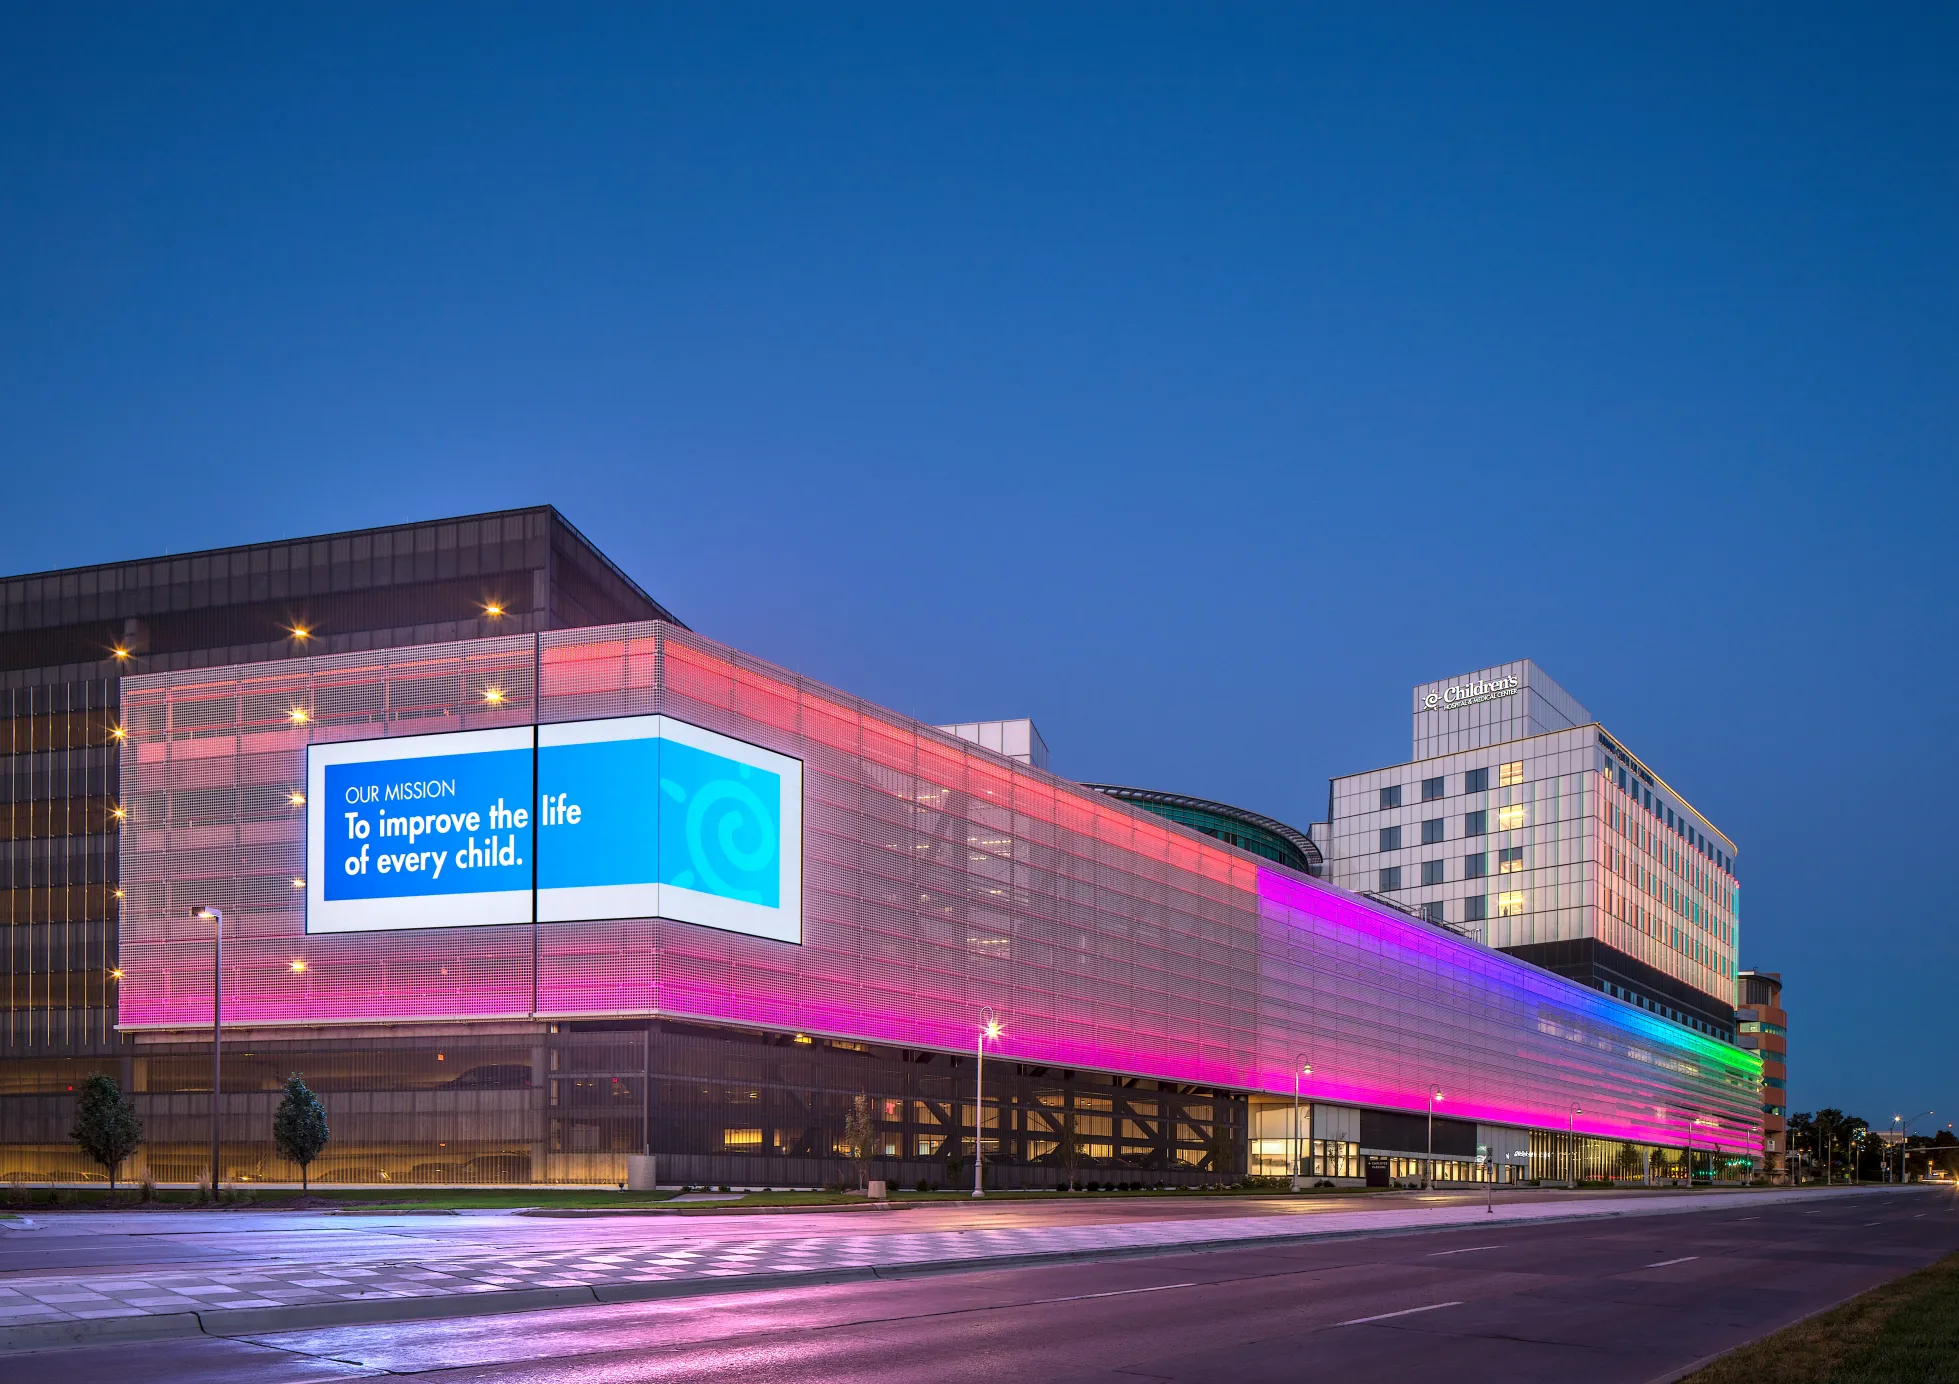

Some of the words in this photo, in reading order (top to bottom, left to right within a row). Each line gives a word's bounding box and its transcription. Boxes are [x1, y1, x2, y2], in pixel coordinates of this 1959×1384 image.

[1444, 675, 1518, 703] Children's
[1444, 700, 1468, 711] HOSPITAL
[1473, 693, 1497, 703] MEDICAL
[1497, 689, 1518, 698] CENTER
[345, 785, 379, 804] OUR
[385, 779, 456, 801] MISSION
[345, 811, 371, 840] To
[379, 808, 481, 844] improve
[489, 798, 528, 829] the
[542, 793, 582, 826] life
[345, 843, 370, 876] of
[377, 850, 448, 879] every
[455, 834, 523, 869] child.
